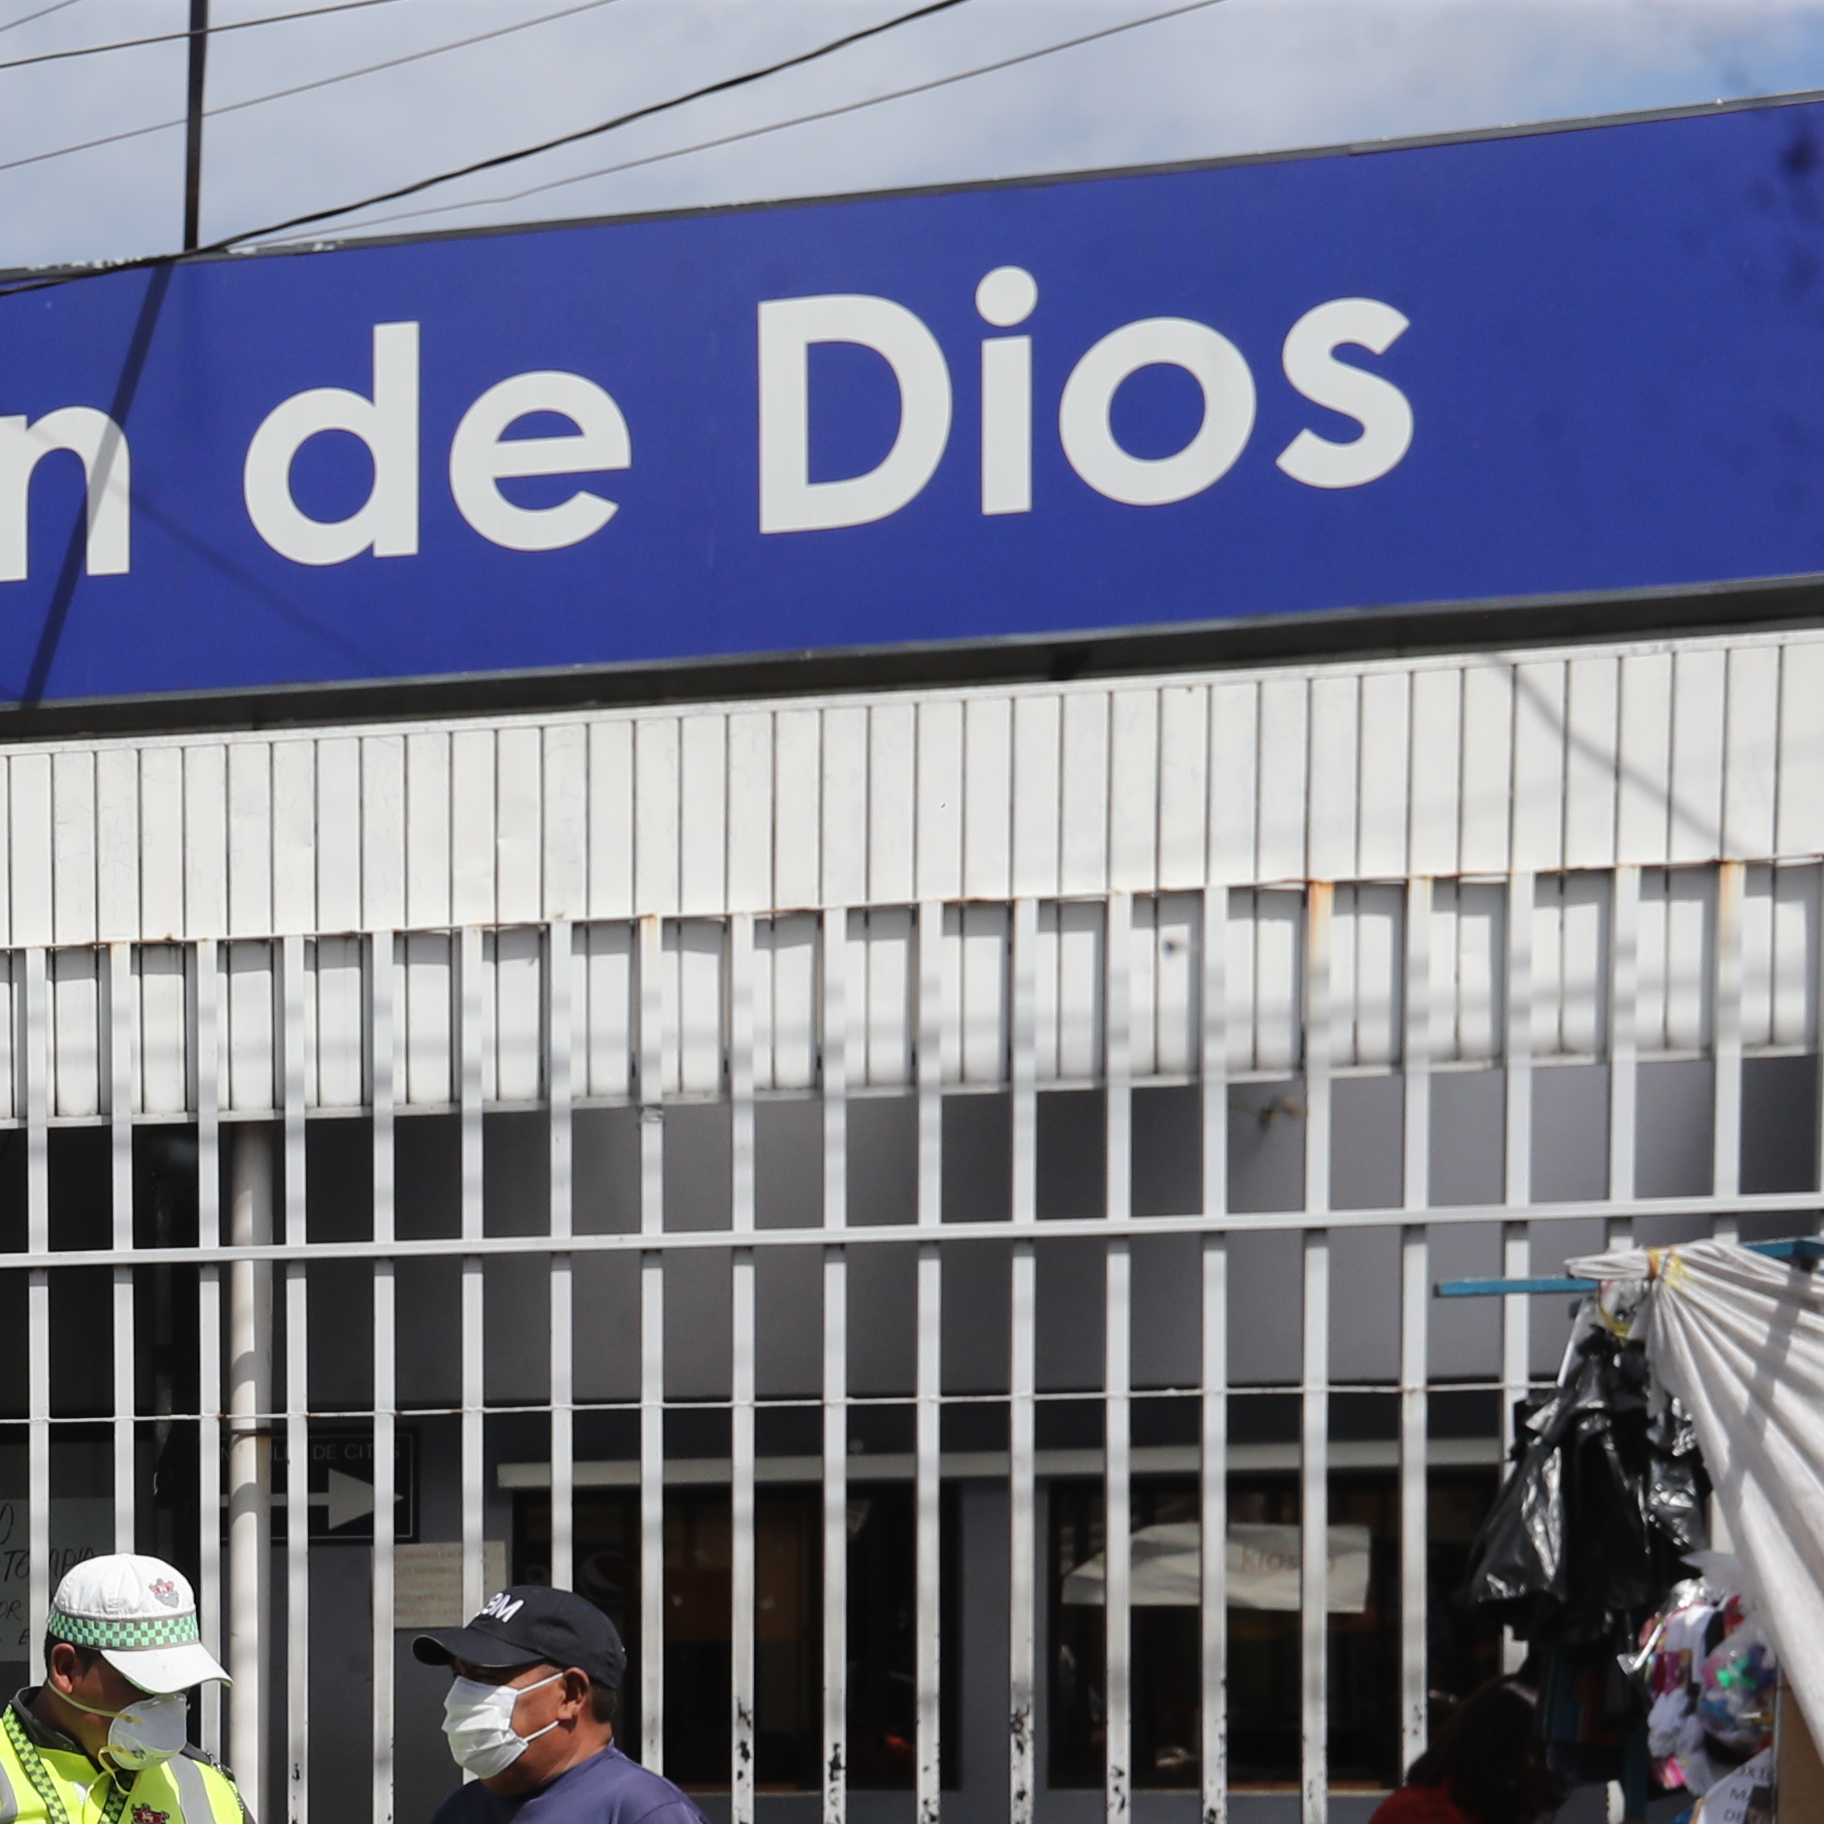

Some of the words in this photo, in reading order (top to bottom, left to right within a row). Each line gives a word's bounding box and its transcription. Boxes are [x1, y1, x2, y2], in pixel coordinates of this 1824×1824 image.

[243, 321, 632, 565] de
[757, 266, 1414, 534] Dios
[344, 1443, 400, 1460] CITS
